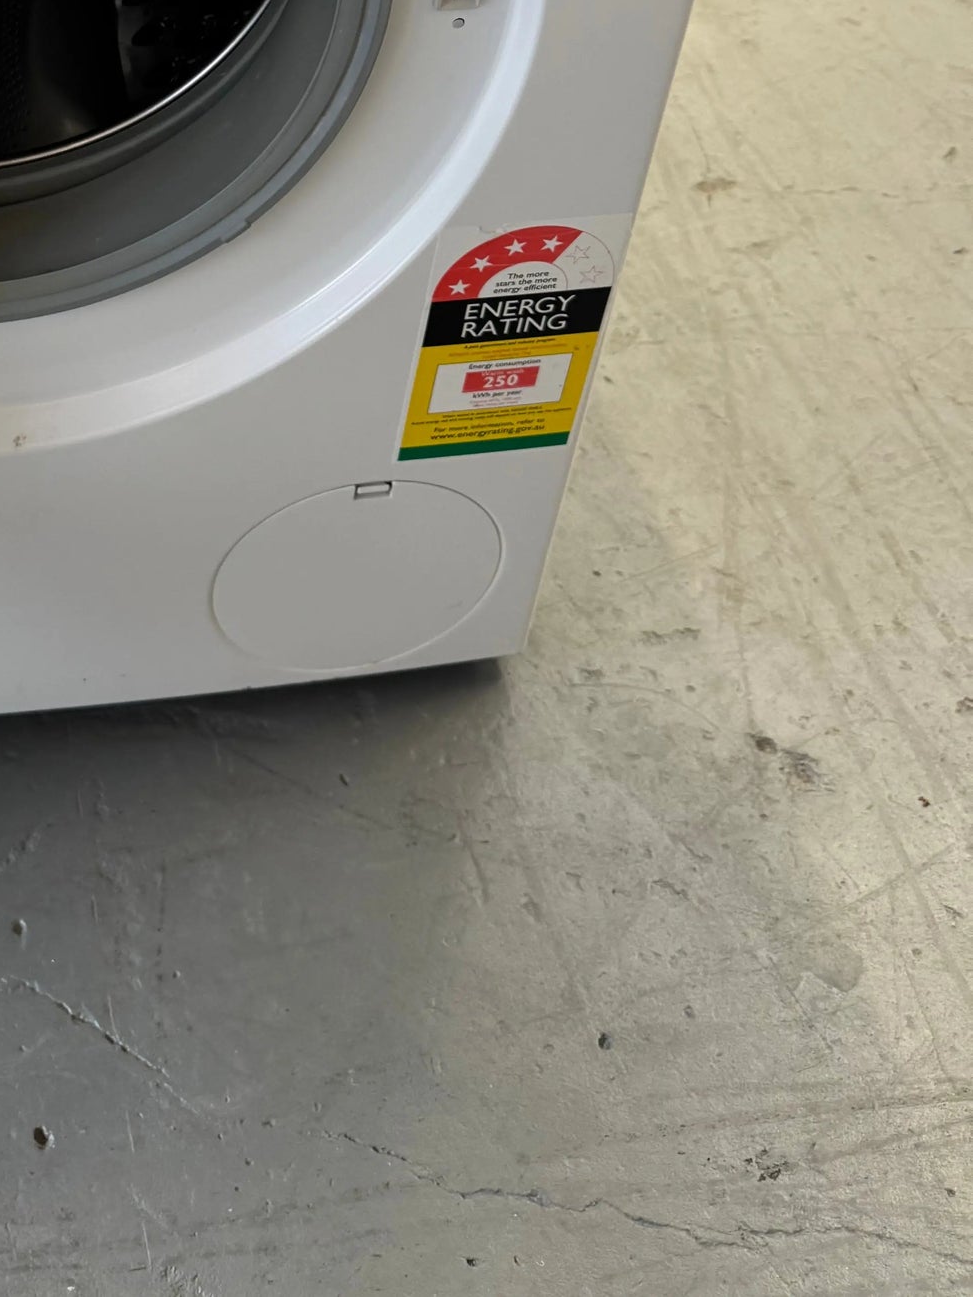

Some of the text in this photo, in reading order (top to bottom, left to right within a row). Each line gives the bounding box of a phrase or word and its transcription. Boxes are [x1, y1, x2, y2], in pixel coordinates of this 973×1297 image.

[493, 283, 557, 294] energy efficient
[464, 294, 576, 320] ENERGY
[460, 313, 569, 338] RATING
[468, 359, 541, 370] Energy consumption
[482, 374, 519, 388] 250
[430, 425, 546, 440] www.energyrating.gov.au
